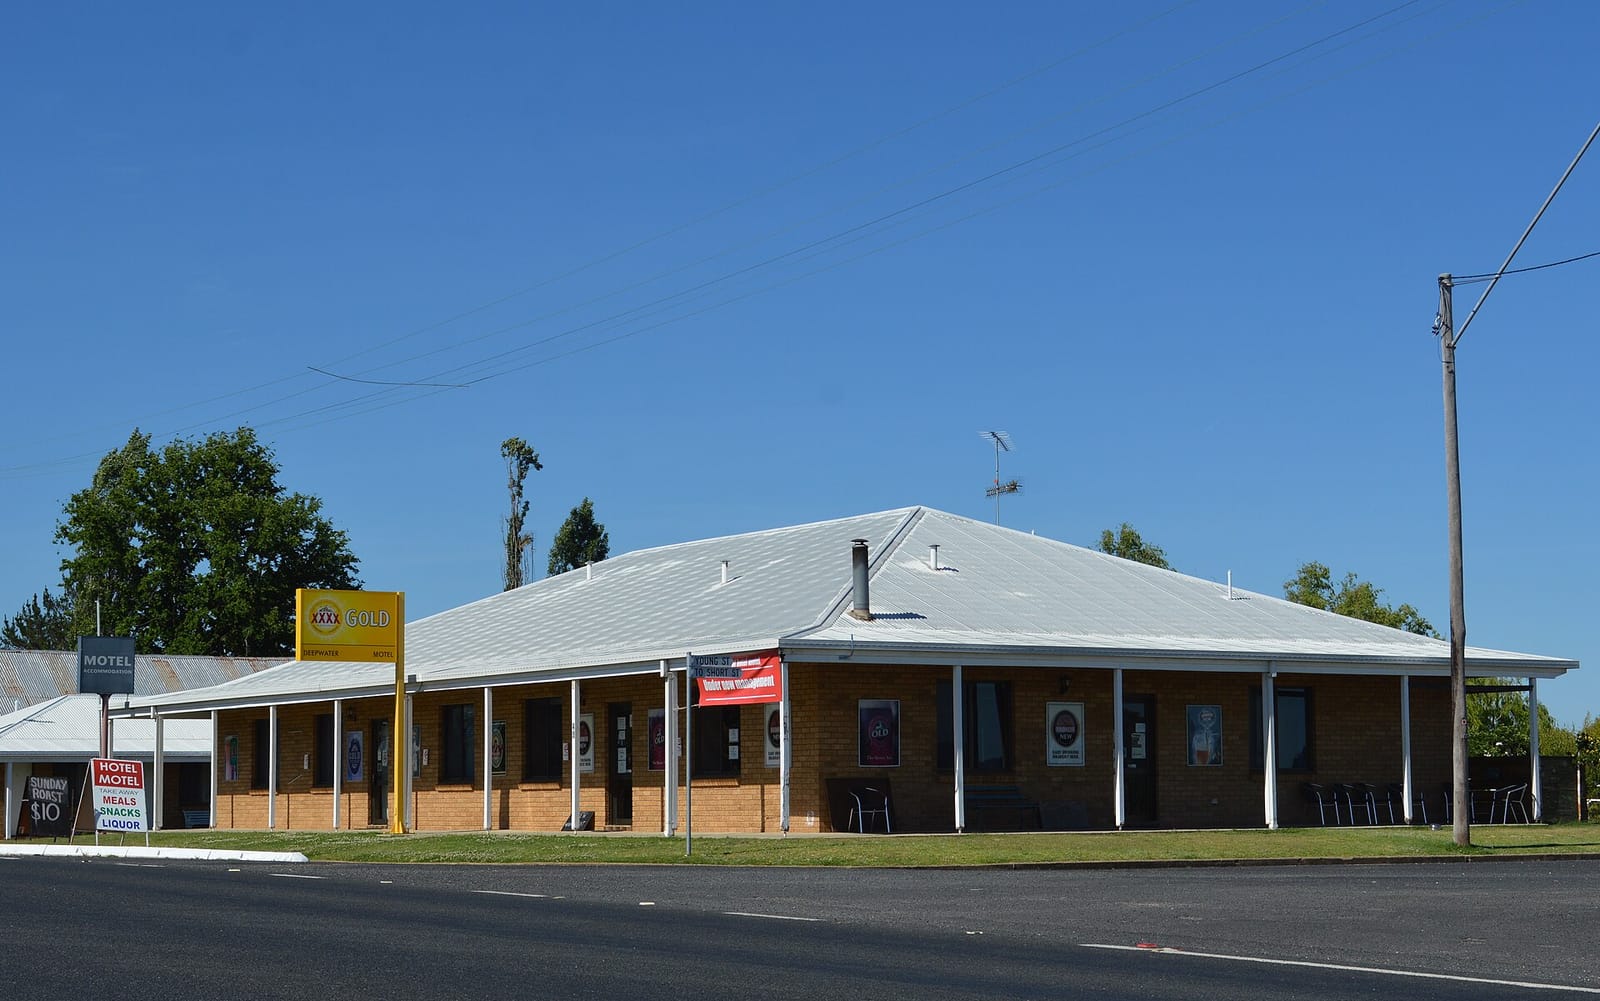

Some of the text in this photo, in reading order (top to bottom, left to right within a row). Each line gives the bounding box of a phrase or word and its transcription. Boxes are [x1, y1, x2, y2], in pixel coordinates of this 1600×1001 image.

[311, 609, 391, 628] XXXX GOLD
[84, 655, 132, 667] MOTEL
[696, 656, 719, 666] YOUNG
[722, 656, 730, 666] ST
[695, 667, 740, 677] TO SHORT ST
[703, 679, 721, 691] Under
[721, 680, 735, 690] new
[872, 728, 889, 738] OLD
[100, 762, 138, 773] HOTEL
[30, 776, 67, 790] SUNDAY
[99, 775, 139, 786] MOTEL
[32, 788, 64, 802] ROAST
[103, 796, 137, 806] MEALS
[31, 802, 60, 822] $10
[100, 807, 141, 817] SNACKS
[102, 819, 140, 829] LIQUOR
